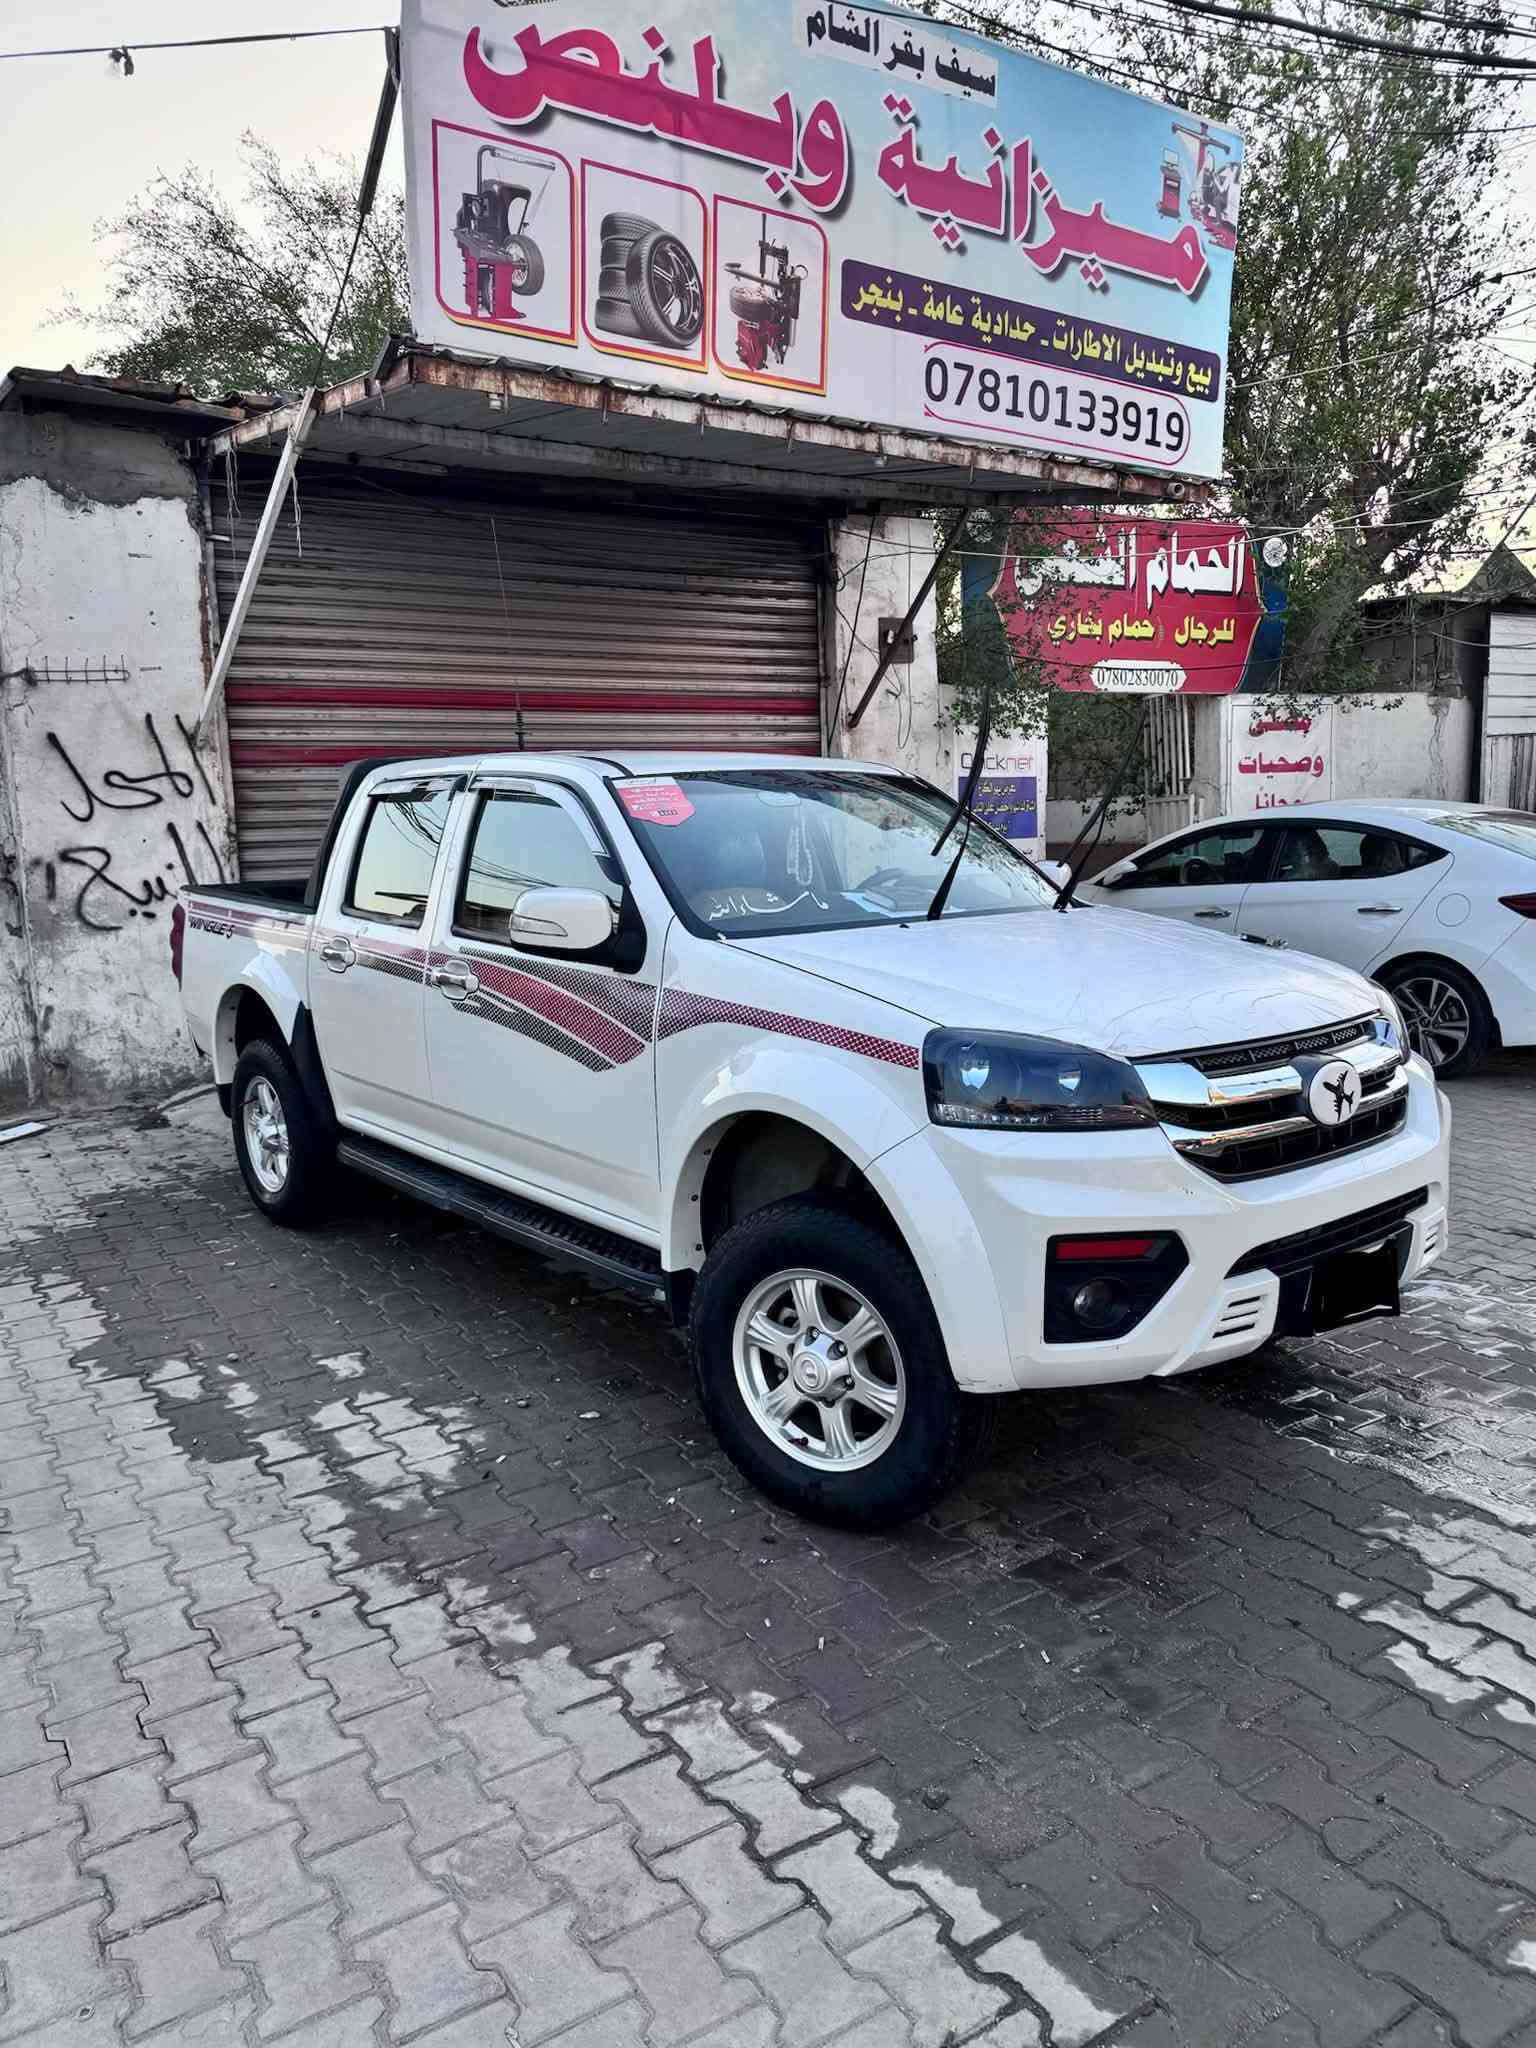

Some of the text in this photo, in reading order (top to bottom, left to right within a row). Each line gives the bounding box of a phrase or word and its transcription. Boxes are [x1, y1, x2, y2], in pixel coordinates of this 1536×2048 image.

[807, 4, 996, 97] سيف بقر الشام
[463, 23, 1208, 295] ميزانية وبلنص
[851, 276, 904, 322] بنجر
[922, 284, 965, 326] عامة
[970, 296, 1036, 343] حدادية
[1052, 320, 1120, 362] الاطارات
[1125, 347, 1184, 386] وتبديل
[1187, 365, 1213, 395] بيع
[924, 357, 1185, 451] 07810133919
[1146, 529, 1247, 611] الحمام
[1048, 610, 1235, 647] للرجال حمام بخاري
[1097, 668, 1179, 687] 07802830070
[1238, 752, 1325, 779] وصحيات
